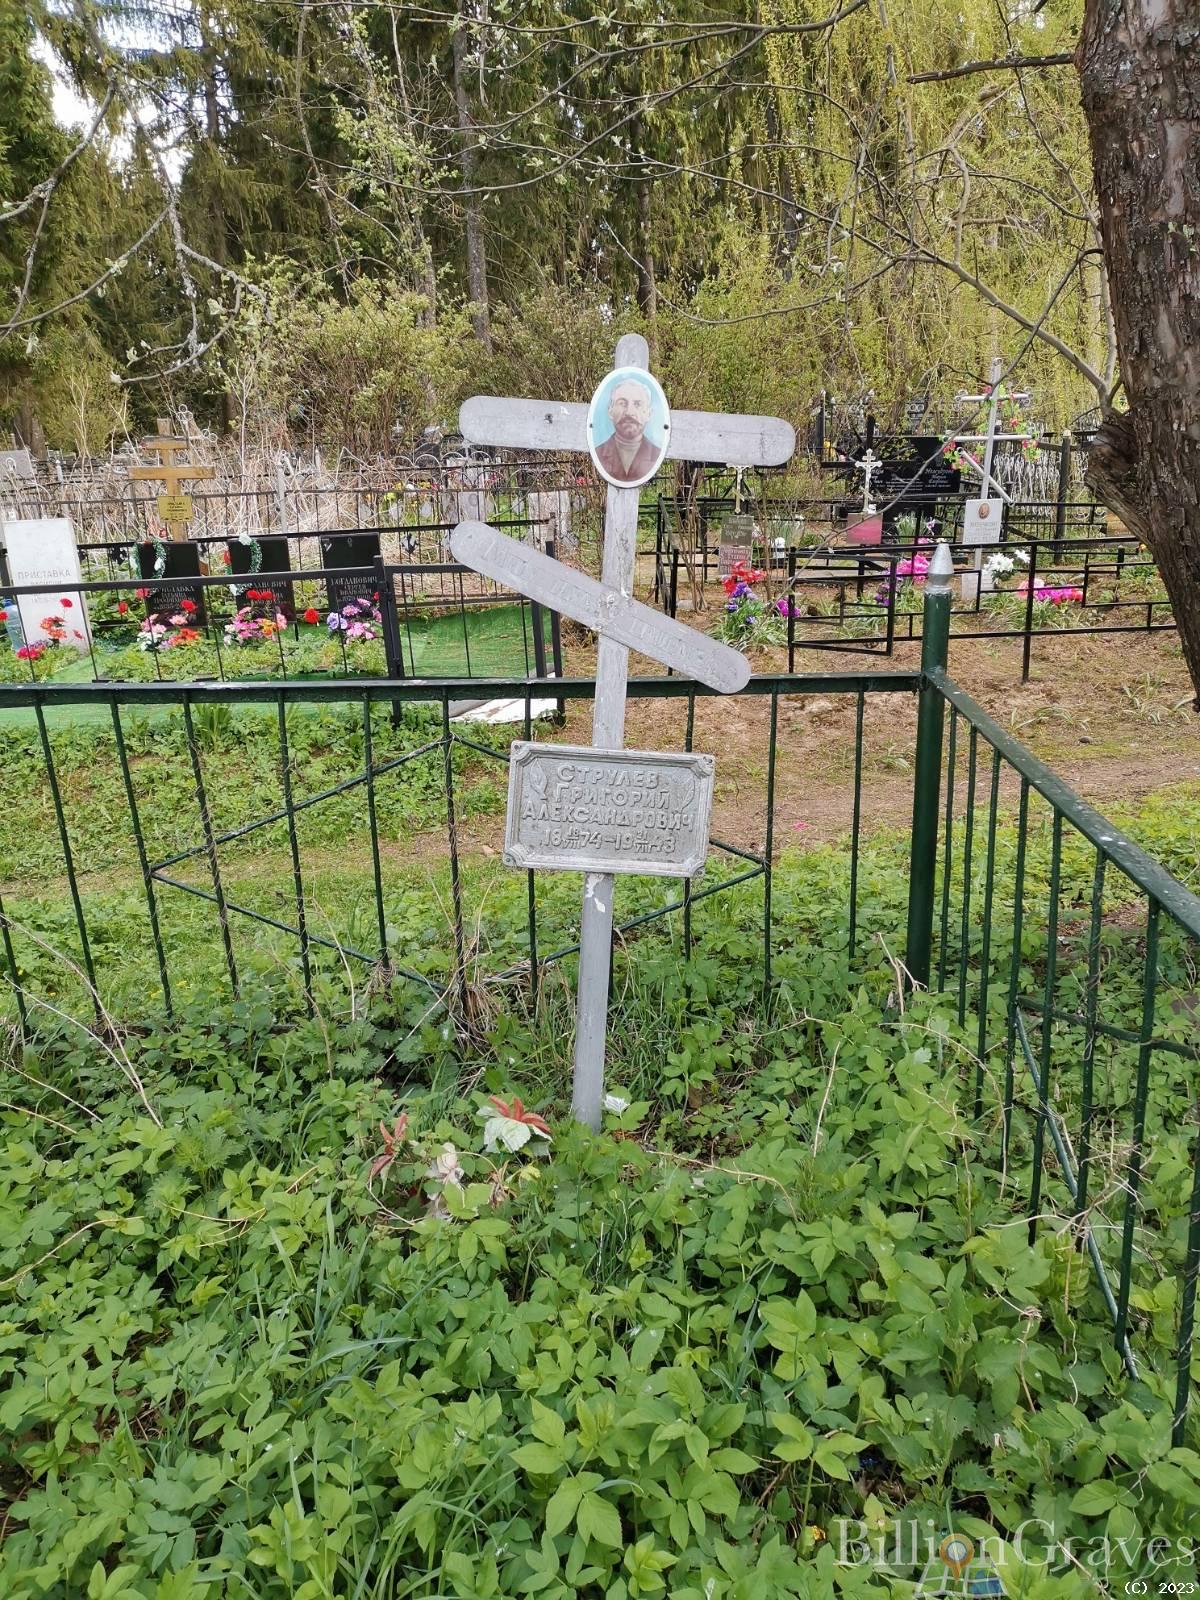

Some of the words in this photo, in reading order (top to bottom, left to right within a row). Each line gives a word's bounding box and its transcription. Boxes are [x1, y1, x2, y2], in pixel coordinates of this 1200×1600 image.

[16, 568, 73, 581] ПРИСТАВКА
[557, 763, 660, 791] СТРУЛЕВ
[554, 782, 671, 810] ГРИГОРИЙ
[521, 799, 695, 833] АЛЕКСАНДРОВИЧ
